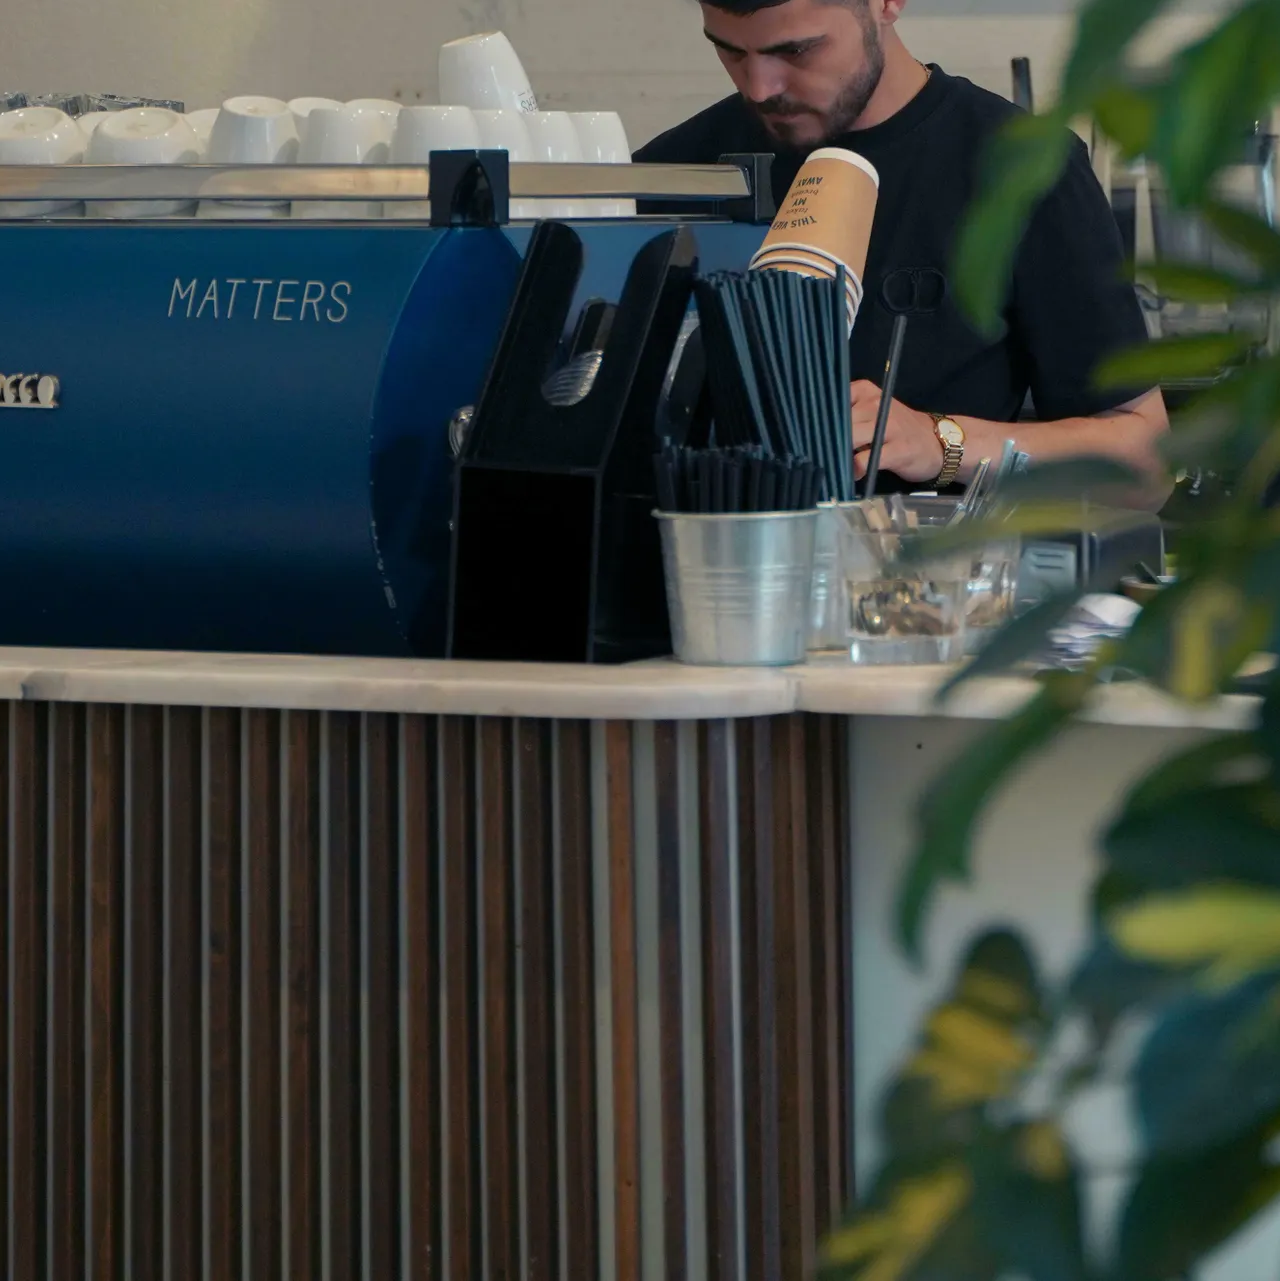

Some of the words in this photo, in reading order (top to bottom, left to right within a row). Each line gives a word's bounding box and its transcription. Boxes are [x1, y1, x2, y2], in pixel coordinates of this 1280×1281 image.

[792, 197, 807, 207] MY
[790, 215, 817, 228] THIS
[168, 278, 351, 322] MATTERS
